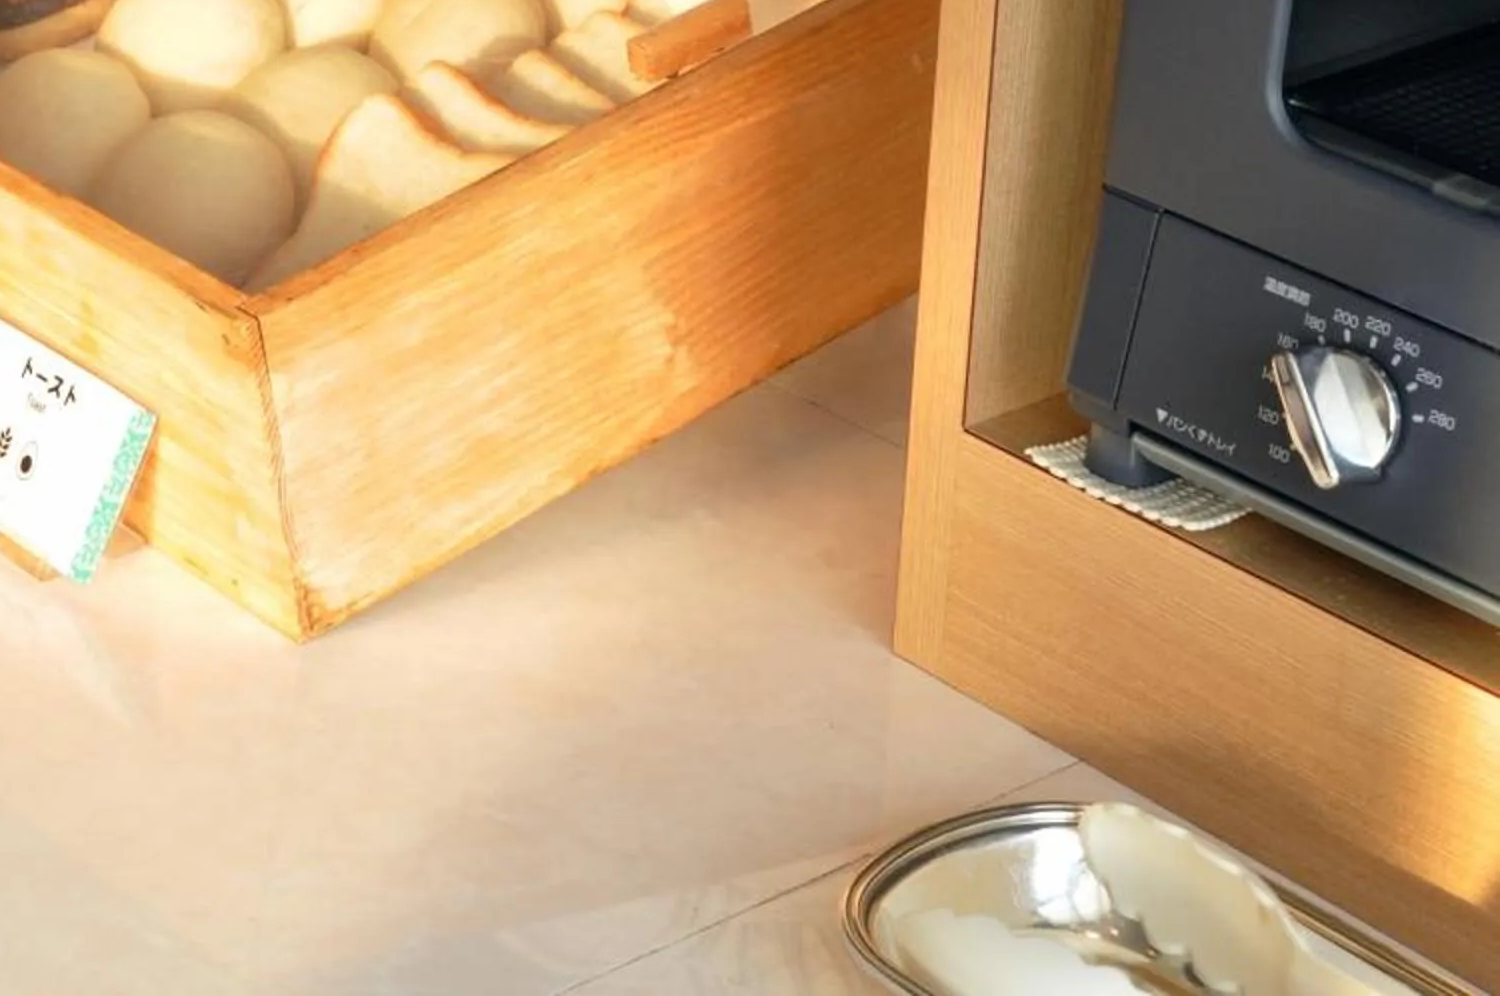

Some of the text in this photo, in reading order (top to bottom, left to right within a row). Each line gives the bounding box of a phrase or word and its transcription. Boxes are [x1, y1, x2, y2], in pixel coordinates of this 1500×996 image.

[1333, 307, 1359, 329] 200
[1364, 315, 1392, 337] 220
[1393, 336, 1421, 358] 240
[20, 356, 78, 407] トースト
[1258, 405, 1280, 425] 120
[1267, 443, 1291, 464] 100
